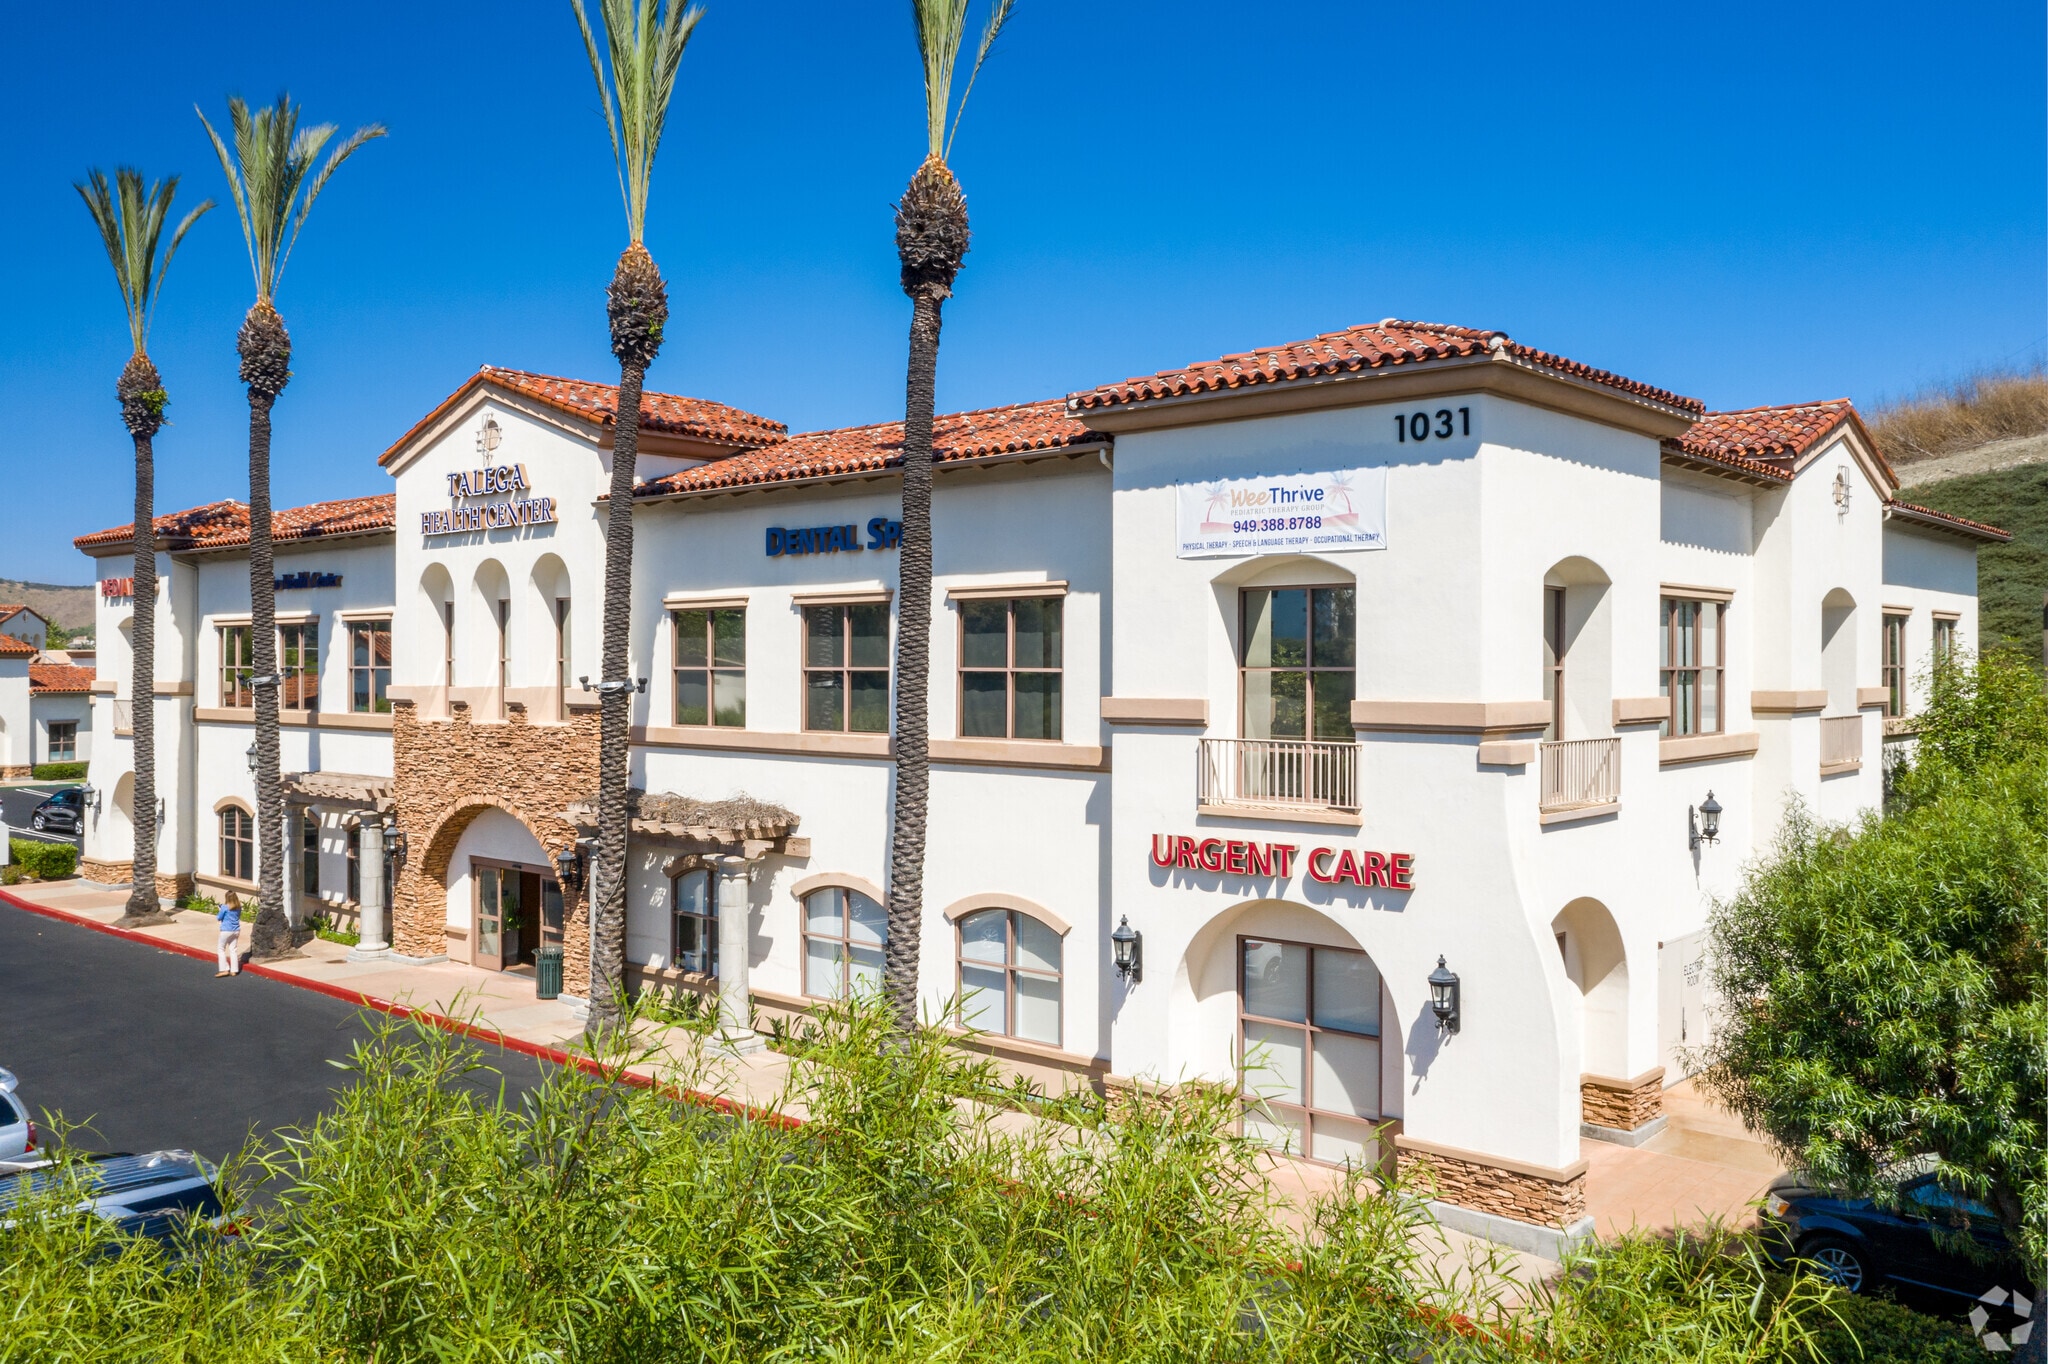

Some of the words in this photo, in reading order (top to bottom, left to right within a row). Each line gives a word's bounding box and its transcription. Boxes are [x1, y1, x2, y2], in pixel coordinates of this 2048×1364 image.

[1394, 407, 1470, 443] 1031
[446, 464, 527, 497] TALEGA
[420, 506, 482, 535] HEALTH
[485, 497, 554, 529] CENTER
[1230, 507, 1266, 516] PEDIATRIC
[1268, 505, 1299, 514] THERAPY
[1301, 503, 1325, 512] GROUP
[1233, 516, 1322, 533] 949.388.8788
[1182, 542, 1205, 551] PHYSICAL
[1206, 541, 1228, 549] THERAPY
[1232, 540, 1252, 548] SPEECH
[1252, 539, 1257, 547] &
[1257, 538, 1284, 547] LANGUAGE
[1285, 536, 1309, 545] THERAPY
[1313, 534, 1353, 544] OCCUPATIONAL
[1354, 532, 1380, 542] THERAPY
[1152, 833, 1298, 878] URGENT
[1308, 847, 1414, 890] CARE
